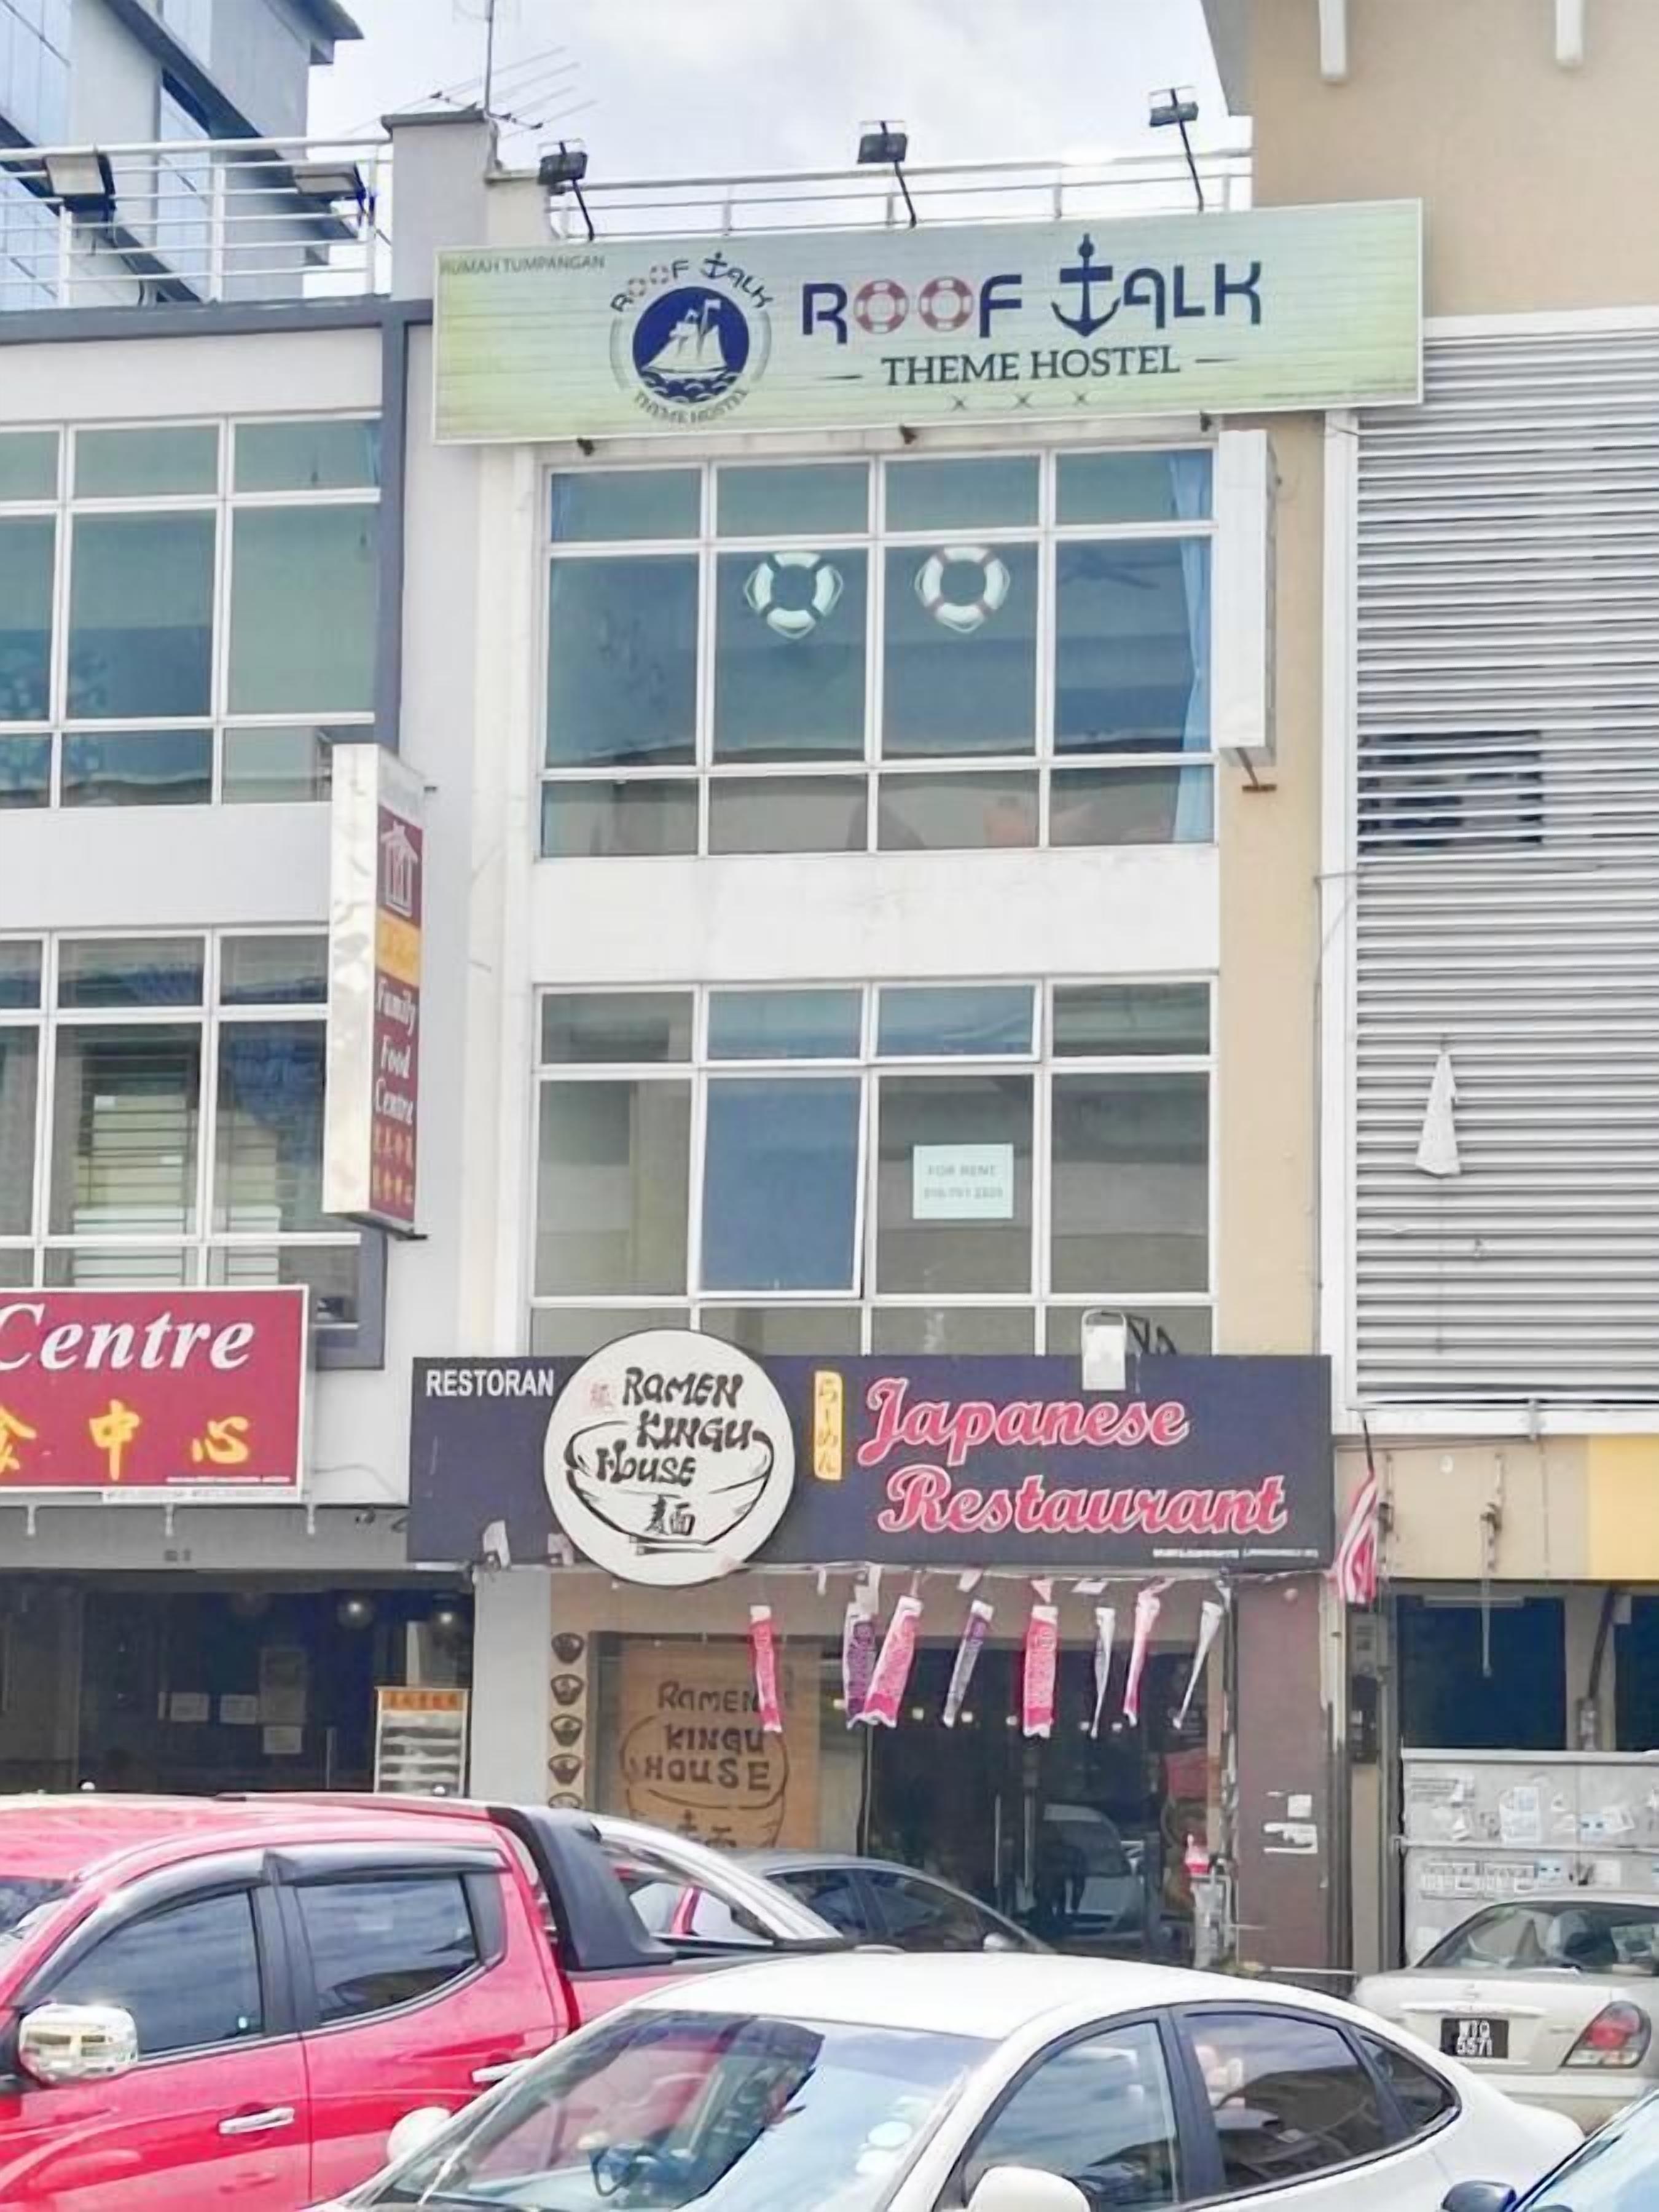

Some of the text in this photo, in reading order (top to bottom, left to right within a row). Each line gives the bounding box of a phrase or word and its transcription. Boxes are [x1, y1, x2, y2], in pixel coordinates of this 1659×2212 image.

[440, 254, 605, 275] RUMAH TUMPANGAN
[802, 274, 1023, 344] ROOF
[881, 345, 1180, 386] THEME HOSTEL
[381, 1034, 411, 1080] Food
[0, 1303, 255, 1371] Centre
[426, 1369, 554, 1398] RESTORAN
[858, 1376, 1190, 1467] Japanese
[596, 1439, 697, 1486] HOUSE
[878, 1465, 1289, 1535] Restaurant
[643, 1755, 772, 1792] HOUSE
